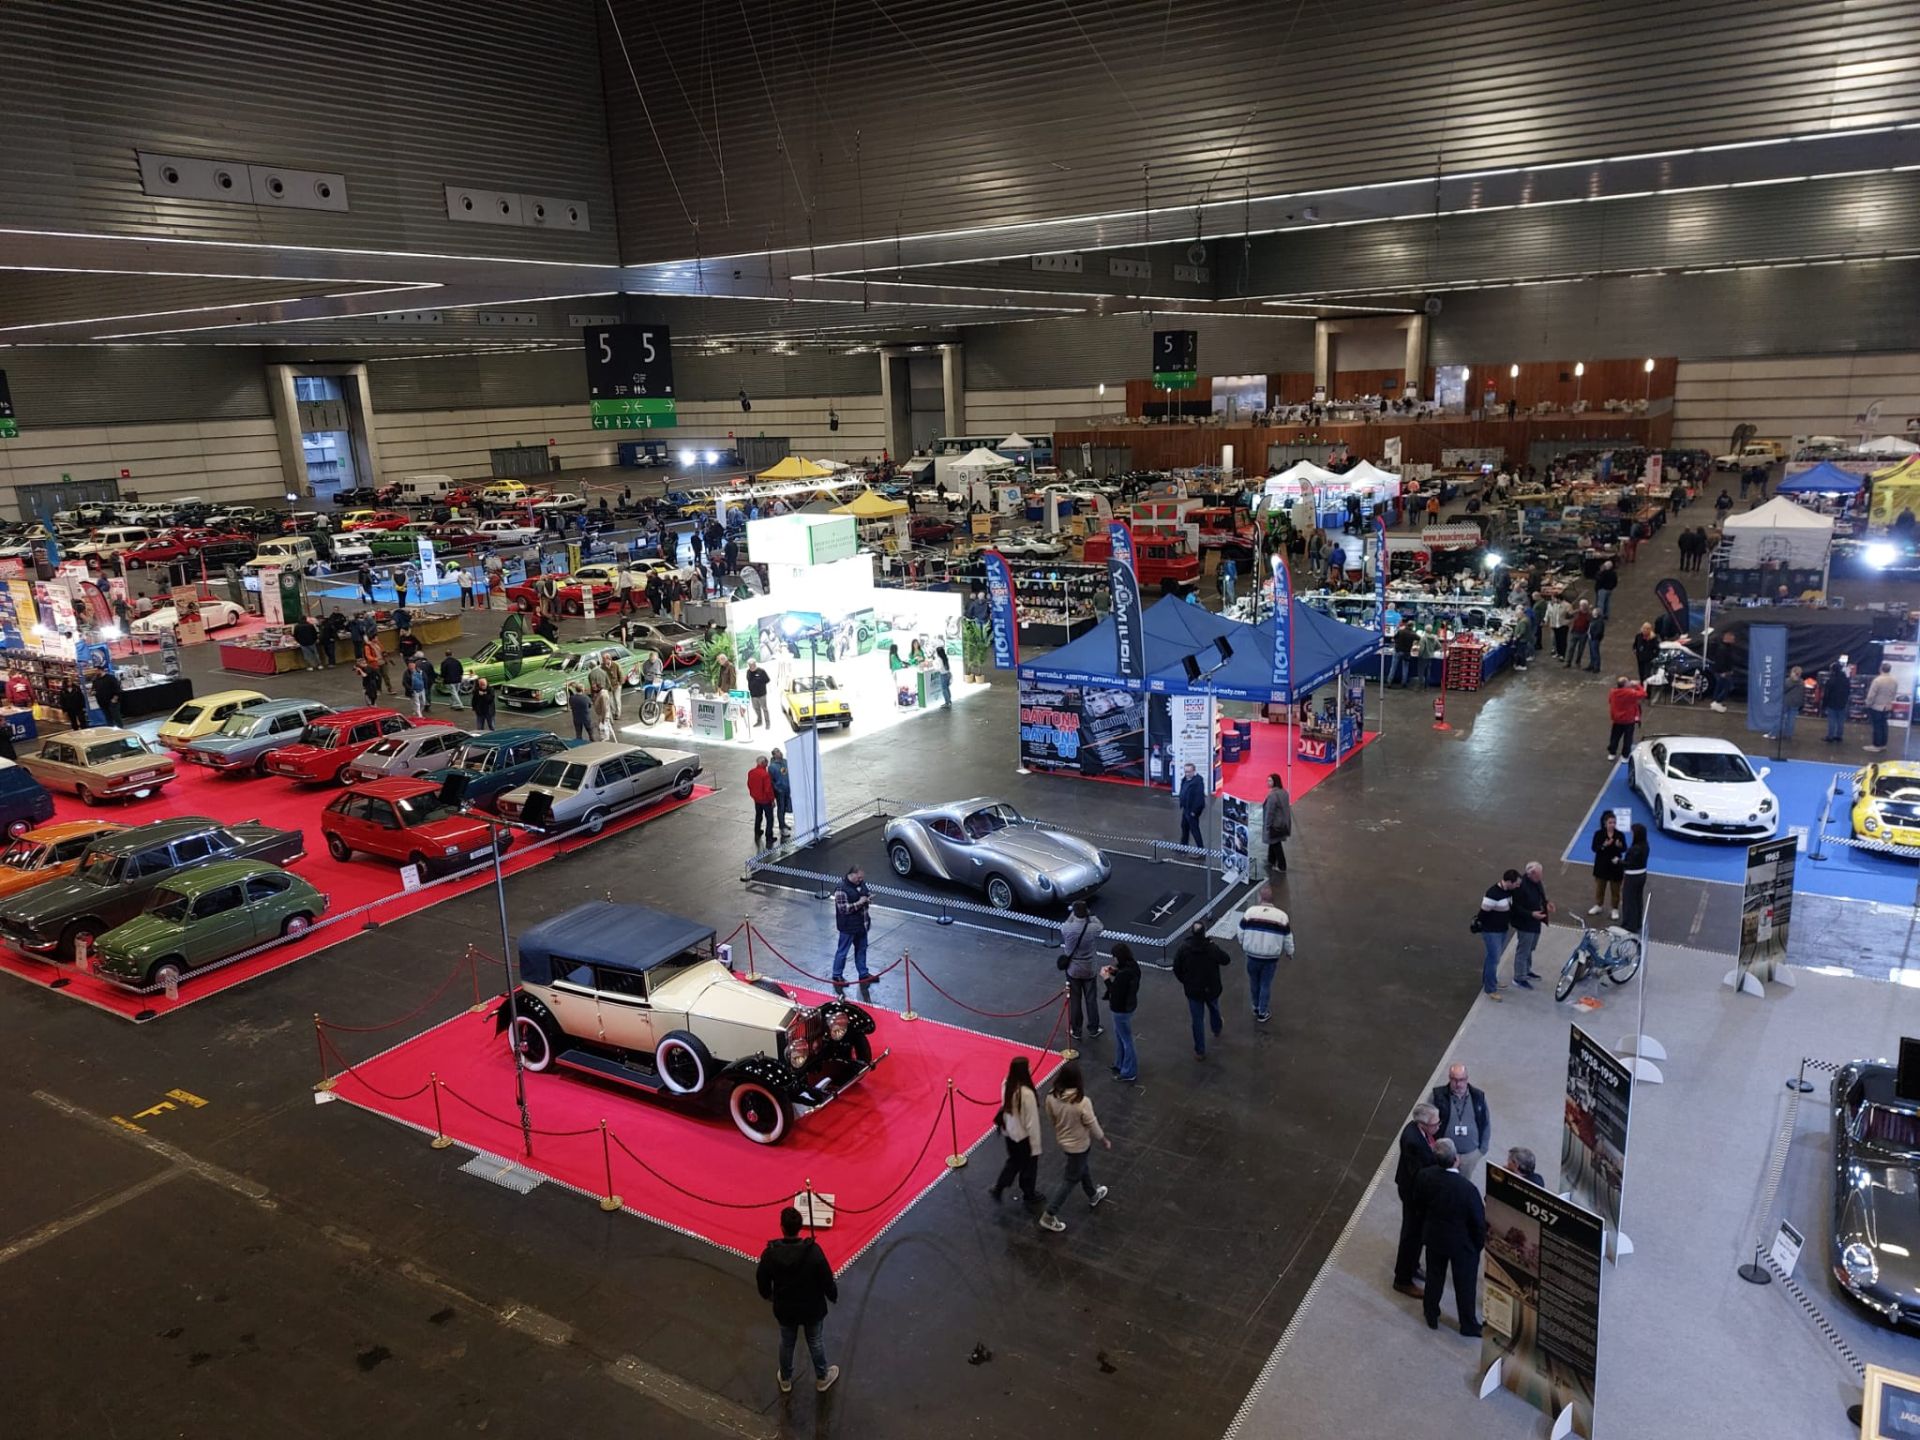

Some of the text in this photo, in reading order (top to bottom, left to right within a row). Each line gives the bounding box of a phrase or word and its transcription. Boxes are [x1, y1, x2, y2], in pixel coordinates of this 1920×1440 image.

[599, 333, 612, 363] 5
[642, 332, 656, 363] 5
[1164, 335, 1173, 353] 5
[1188, 335, 1193, 352] 5
[1022, 708, 1081, 729] DAYTONA
[1022, 726, 1081, 747] DAYTONA
[1058, 743, 1077, 759] 80
[1580, 1048, 1619, 1088] 1958-1959
[1524, 1201, 1560, 1226] 1957
